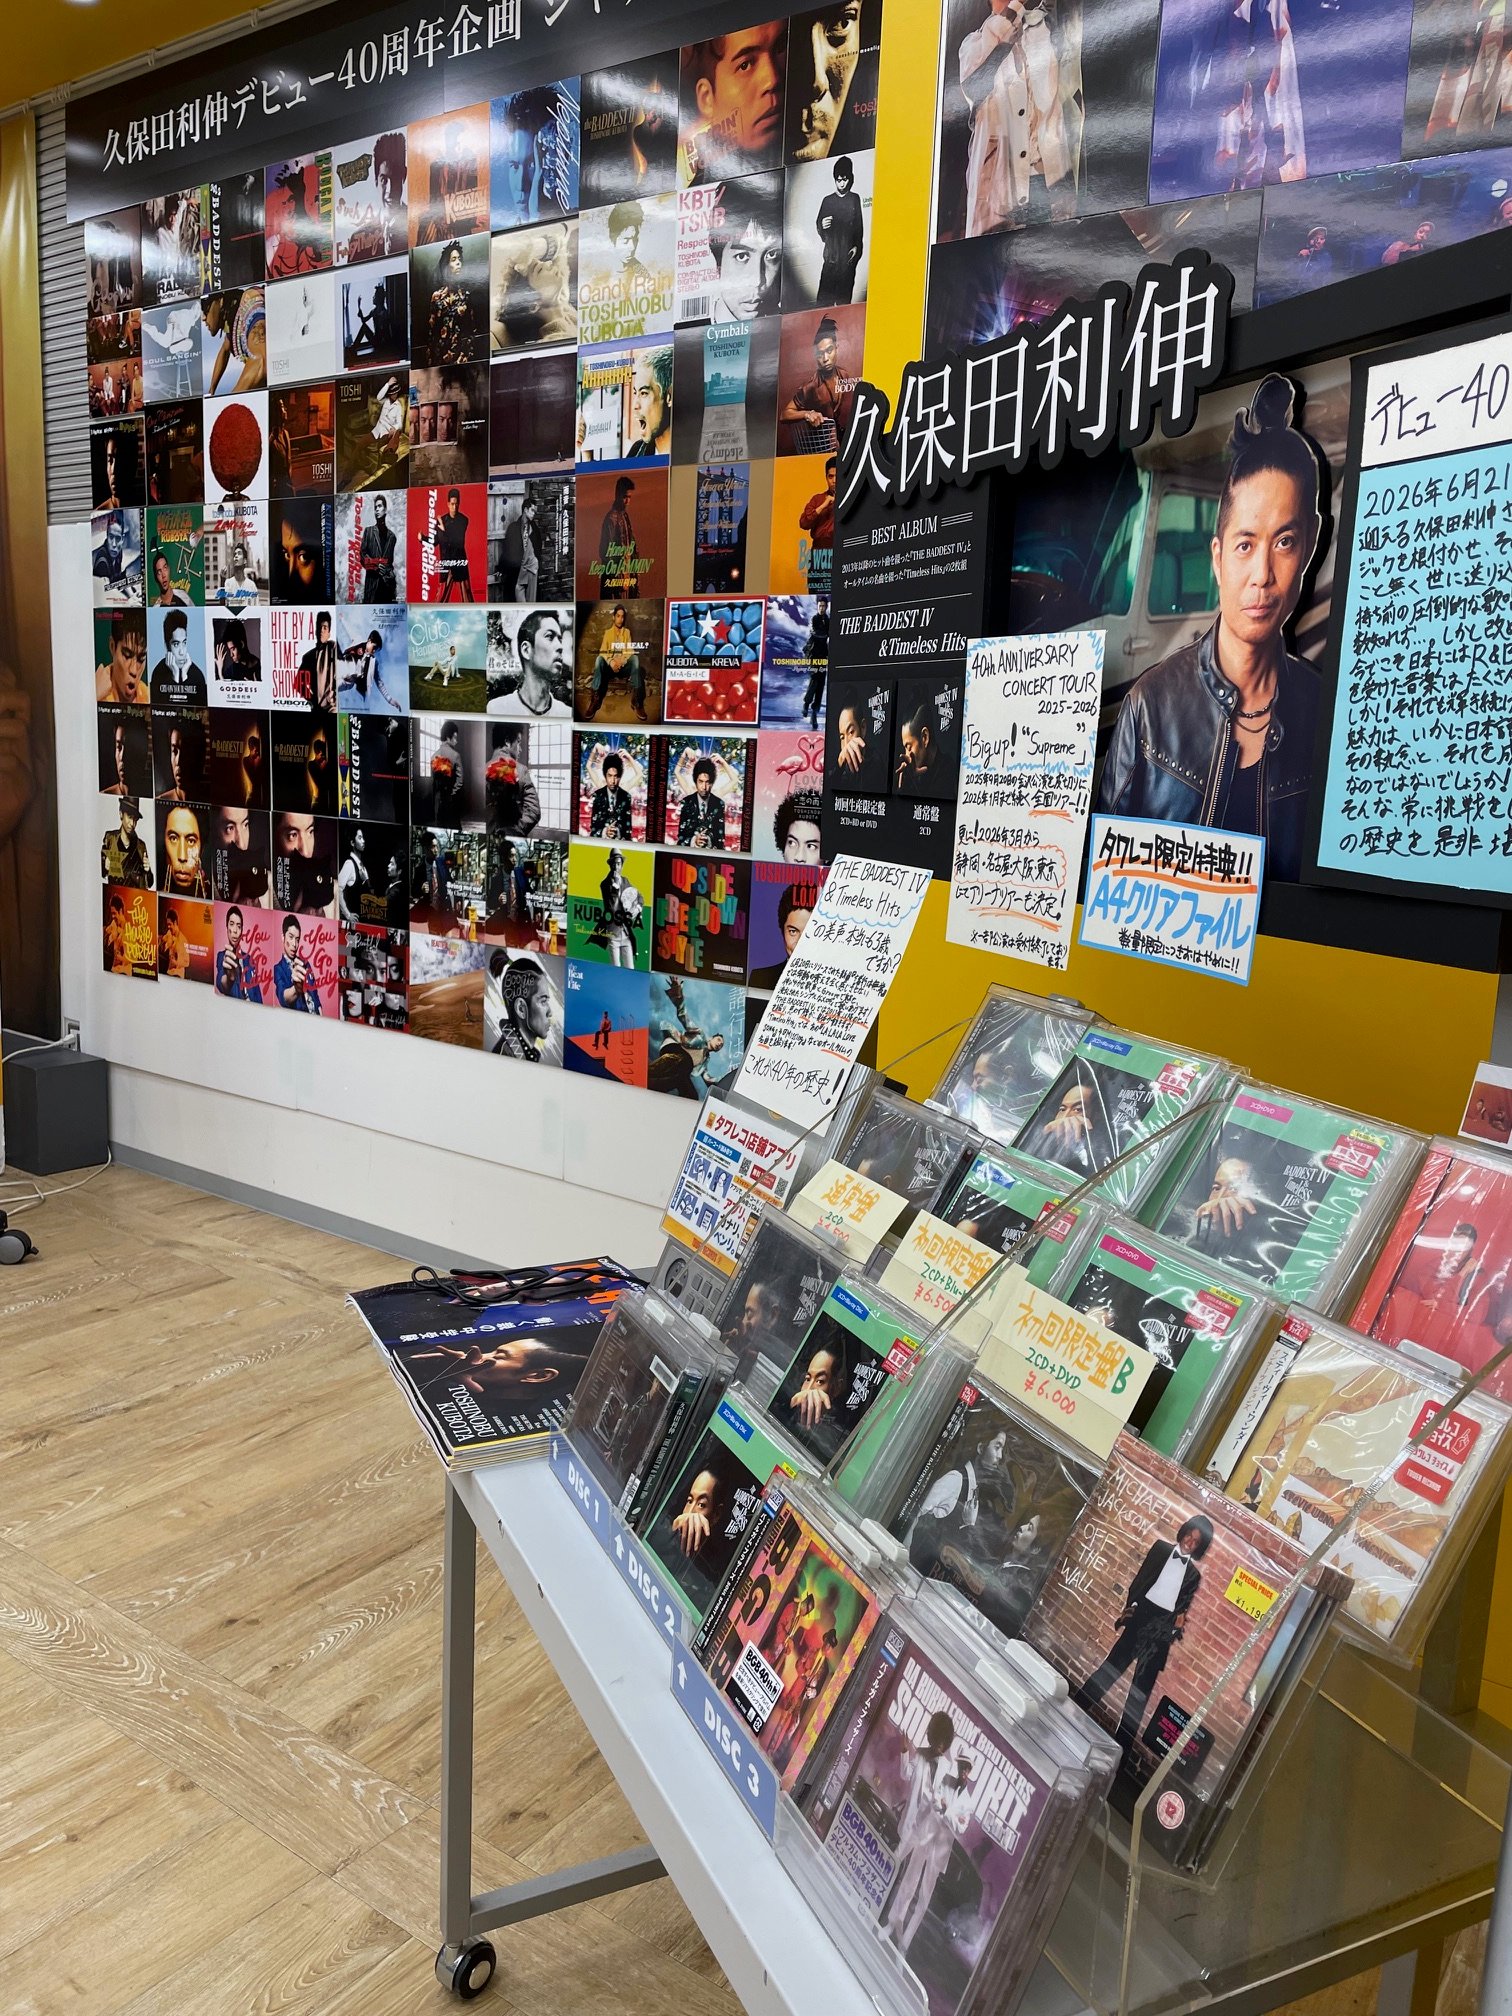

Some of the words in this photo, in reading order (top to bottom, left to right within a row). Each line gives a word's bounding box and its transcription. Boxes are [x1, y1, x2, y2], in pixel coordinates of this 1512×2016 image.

[591, 110, 627, 131] BADDEST
[211, 194, 221, 291] BADDEST
[579, 277, 632, 305] Candy
[635, 270, 673, 293] Rain
[579, 293, 673, 323] TOSHINOBU
[580, 318, 645, 344] KUBOTA
[707, 323, 749, 341] Cymbals
[709, 341, 745, 353] TOSHINOBU
[714, 349, 739, 359] KUBOTA
[340, 384, 361, 397] TOSHI
[838, 266, 1219, 509] 久保田利伸
[1371, 363, 1511, 445] デビュー40
[312, 463, 332, 475] TOSHI
[235, 504, 258, 516] KUBOTA
[427, 489, 438, 575] Toshinobu
[871, 525, 896, 545] BEST
[899, 516, 938, 540] ALBUM
[421, 541, 432, 601] Kubota
[271, 612, 288, 640] HIT
[293, 612, 304, 640] BY
[308, 612, 315, 640] A
[410, 620, 451, 646] Club
[840, 616, 862, 635] THE
[863, 610, 919, 633] BADDEST
[920, 608, 935, 626] IV
[272, 641, 298, 669] TIME
[611, 641, 627, 650] FOR
[627, 641, 649, 650] REAL?
[878, 635, 938, 657] &Timeless
[940, 632, 967, 652] Hits
[666, 657, 698, 667] KUBOTA
[711, 656, 740, 667] KREVA
[772, 658, 811, 666] TOSHINOBU
[972, 653, 996, 679] 40th
[998, 644, 1079, 673] ANNIVERSARY
[272, 670, 311, 699] SHOWER
[1003, 675, 1056, 698] CONCERT
[1060, 672, 1097, 694] TOUR
[1038, 696, 1098, 716] 2025-2026
[351, 727, 361, 818] BADDEST
[913, 805, 940, 822] 通常盤
[919, 826, 931, 836] 2CD
[755, 862, 816, 885] TOSHINOBU
[834, 861, 862, 879] THE
[860, 862, 909, 889] BADDEST
[909, 873, 929, 894] IV
[824, 881, 837, 903] &
[836, 885, 874, 910] Timeless
[573, 903, 645, 929] KUBOSSA
[1088, 874, 1251, 949] A4クリアファイル
[250, 945, 268, 973] Go
[504, 973, 536, 988] Boogie
[568, 968, 584, 980] Beat
[568, 980, 581, 991] Life
[1283, 1164, 1318, 1181] BADDEST
[1317, 1169, 1329, 1184] IV
[821, 1174, 881, 1223] 通常盤
[825, 1212, 844, 1226] 2CD
[1115, 1243, 1139, 1262] 2CD+DVD
[1177, 1327, 1190, 1344] IV
[1025, 1346, 1081, 1390] 2CD+DVD
[436, 1401, 475, 1442] KUBOTA
[448, 1384, 497, 1438] TOSHINOBU
[568, 1461, 590, 1511] DISC
[593, 1500, 600, 1523] 1
[1108, 1470, 1173, 1523] MICHAEL
[1097, 1487, 1152, 1535] JACKSON
[1083, 1523, 1118, 1551] OFF
[1076, 1542, 1108, 1571] THE
[1060, 1556, 1094, 1594] WALL
[1239, 1571, 1258, 1590] SPECIAL
[1257, 1584, 1274, 1600] PRICE
[628, 1555, 660, 1613] DISC
[663, 1607, 676, 1636] 2
[704, 1697, 742, 1773] DISC
[747, 1763, 760, 1798] 3
